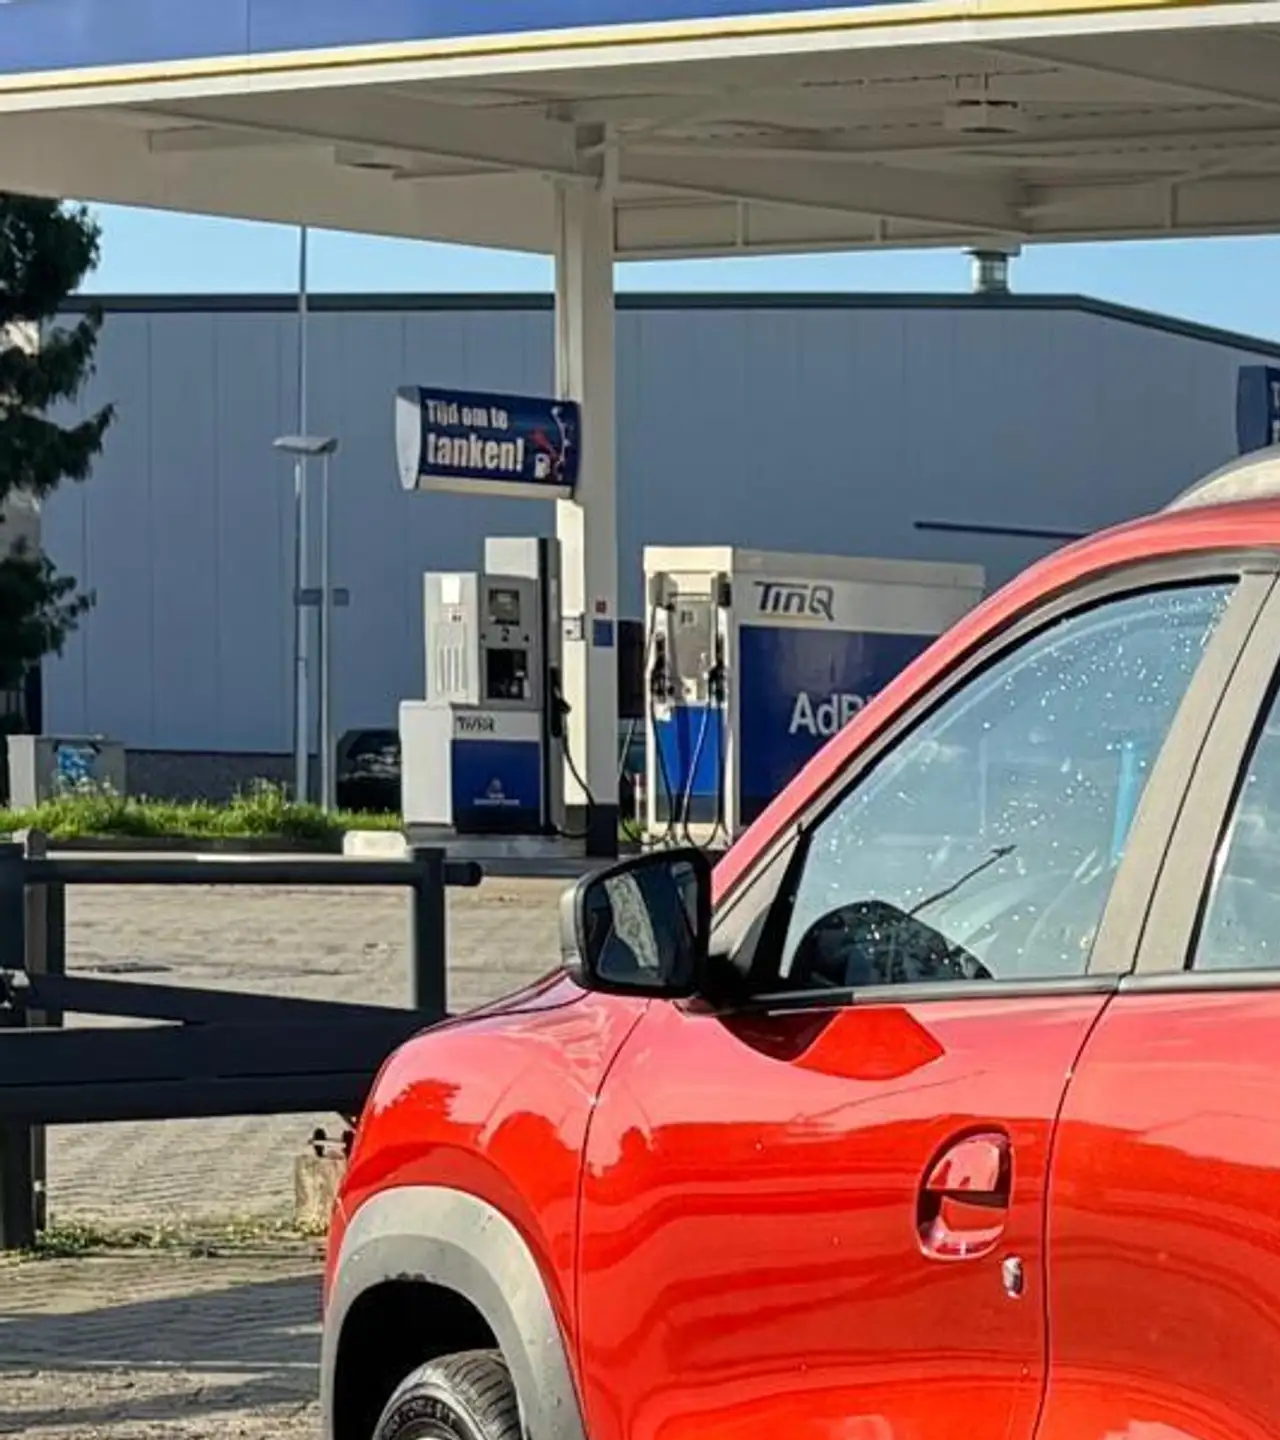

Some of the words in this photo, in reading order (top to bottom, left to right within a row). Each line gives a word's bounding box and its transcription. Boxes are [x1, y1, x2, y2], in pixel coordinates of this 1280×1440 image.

[426, 399, 459, 427] Tijd
[461, 407, 488, 428] om
[491, 407, 509, 430] te
[426, 432, 524, 473] tanken!
